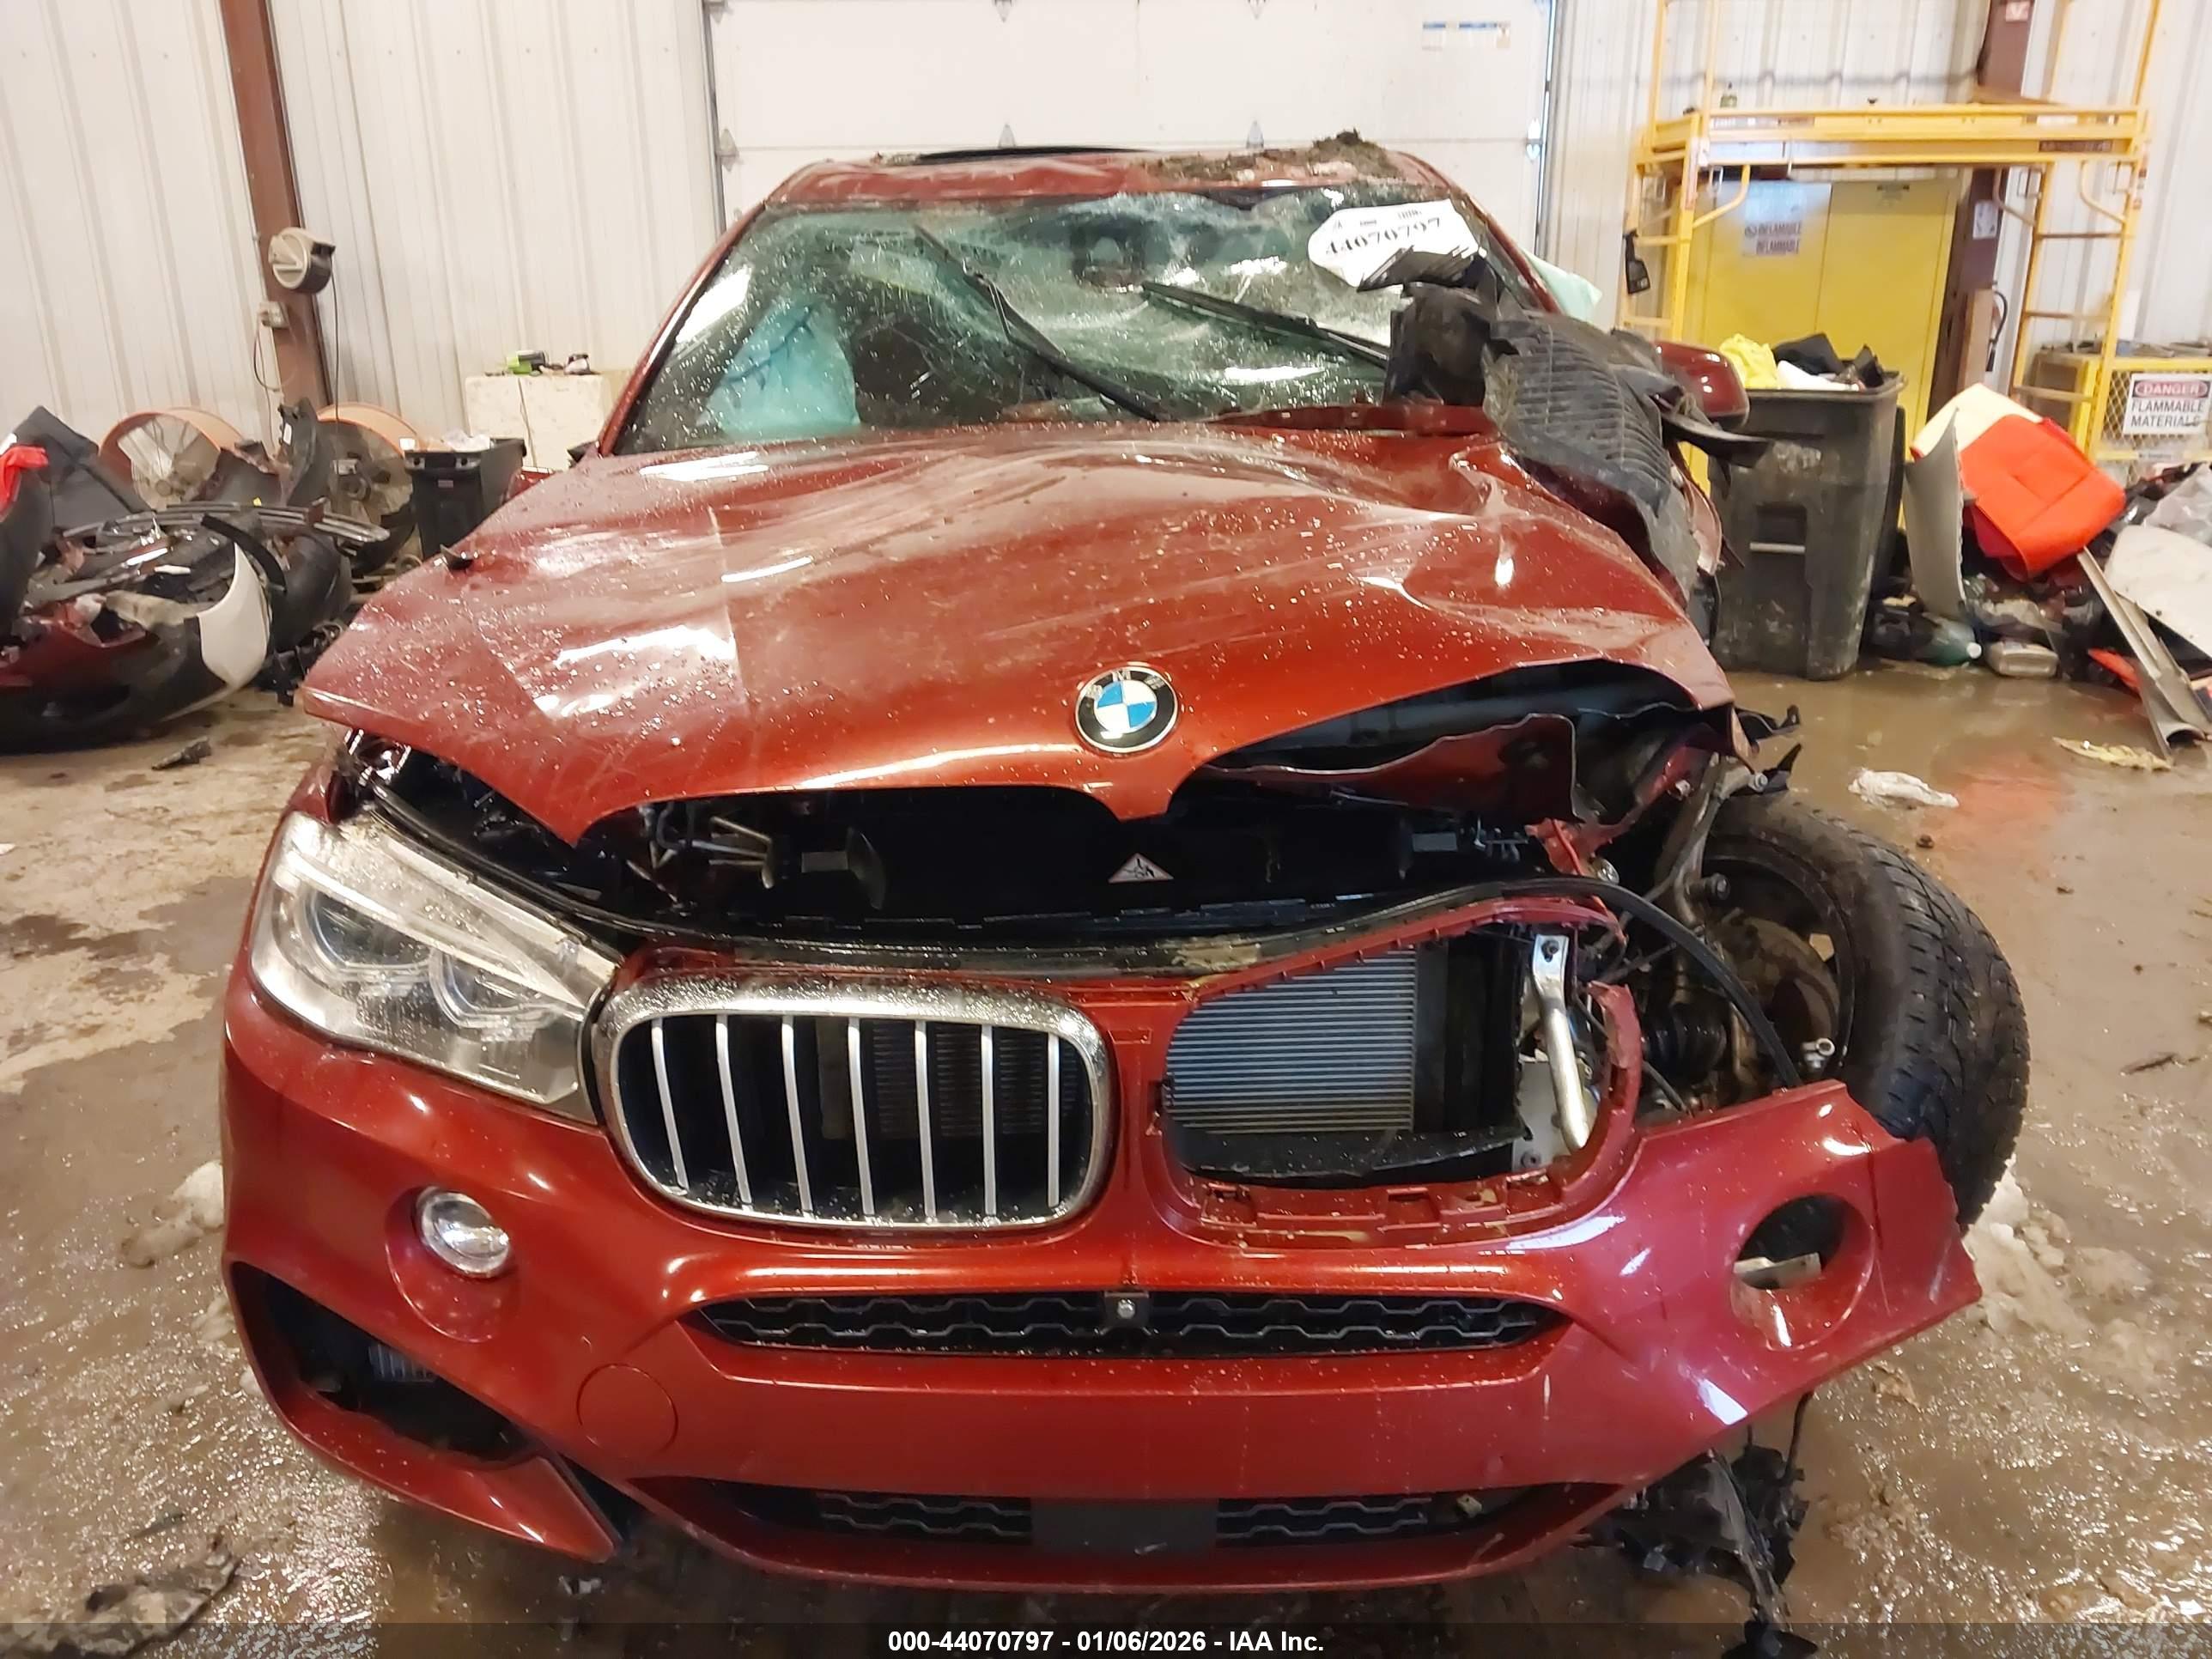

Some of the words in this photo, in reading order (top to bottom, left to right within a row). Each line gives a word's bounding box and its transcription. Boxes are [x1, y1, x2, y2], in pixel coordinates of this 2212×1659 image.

[1326, 217, 1440, 253] 44070797
[2144, 383, 2199, 395] DANGER
[2131, 400, 2204, 412] FLAMMABLE
[2130, 415, 2200, 427] MATERIALS
